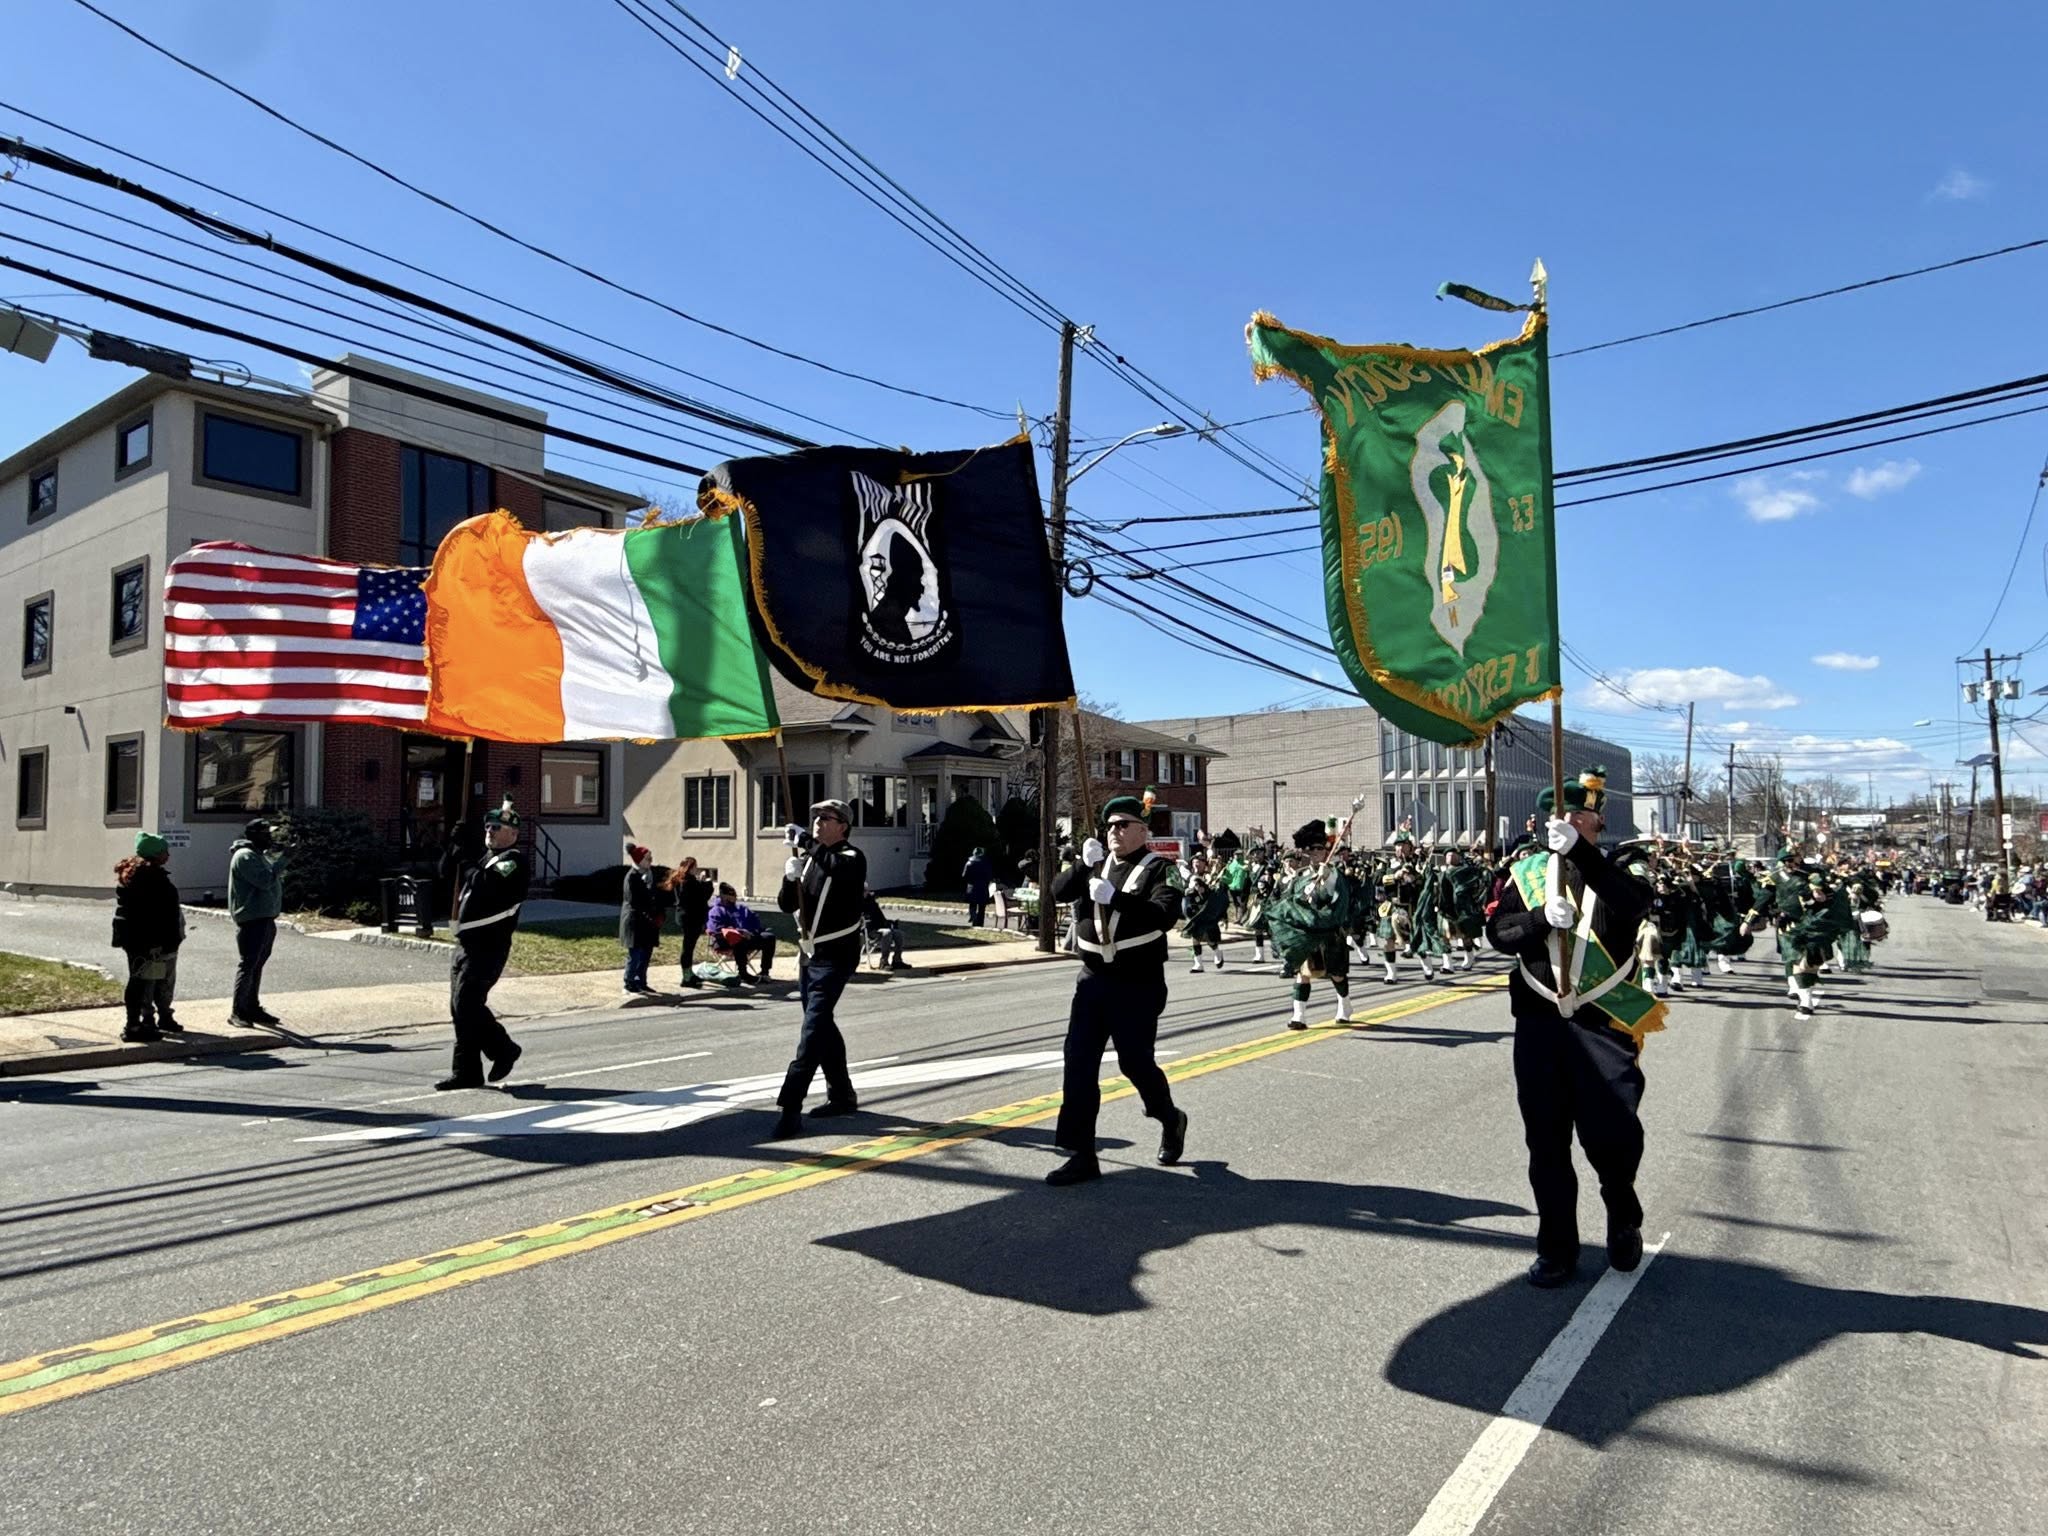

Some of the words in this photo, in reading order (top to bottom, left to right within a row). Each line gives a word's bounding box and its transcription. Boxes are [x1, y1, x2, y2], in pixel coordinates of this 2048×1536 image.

[860, 635, 874, 653] YOU
[873, 649, 891, 662] ARE
[894, 655, 911, 664] NOT
[912, 630, 953, 662] FORGOTTEN
